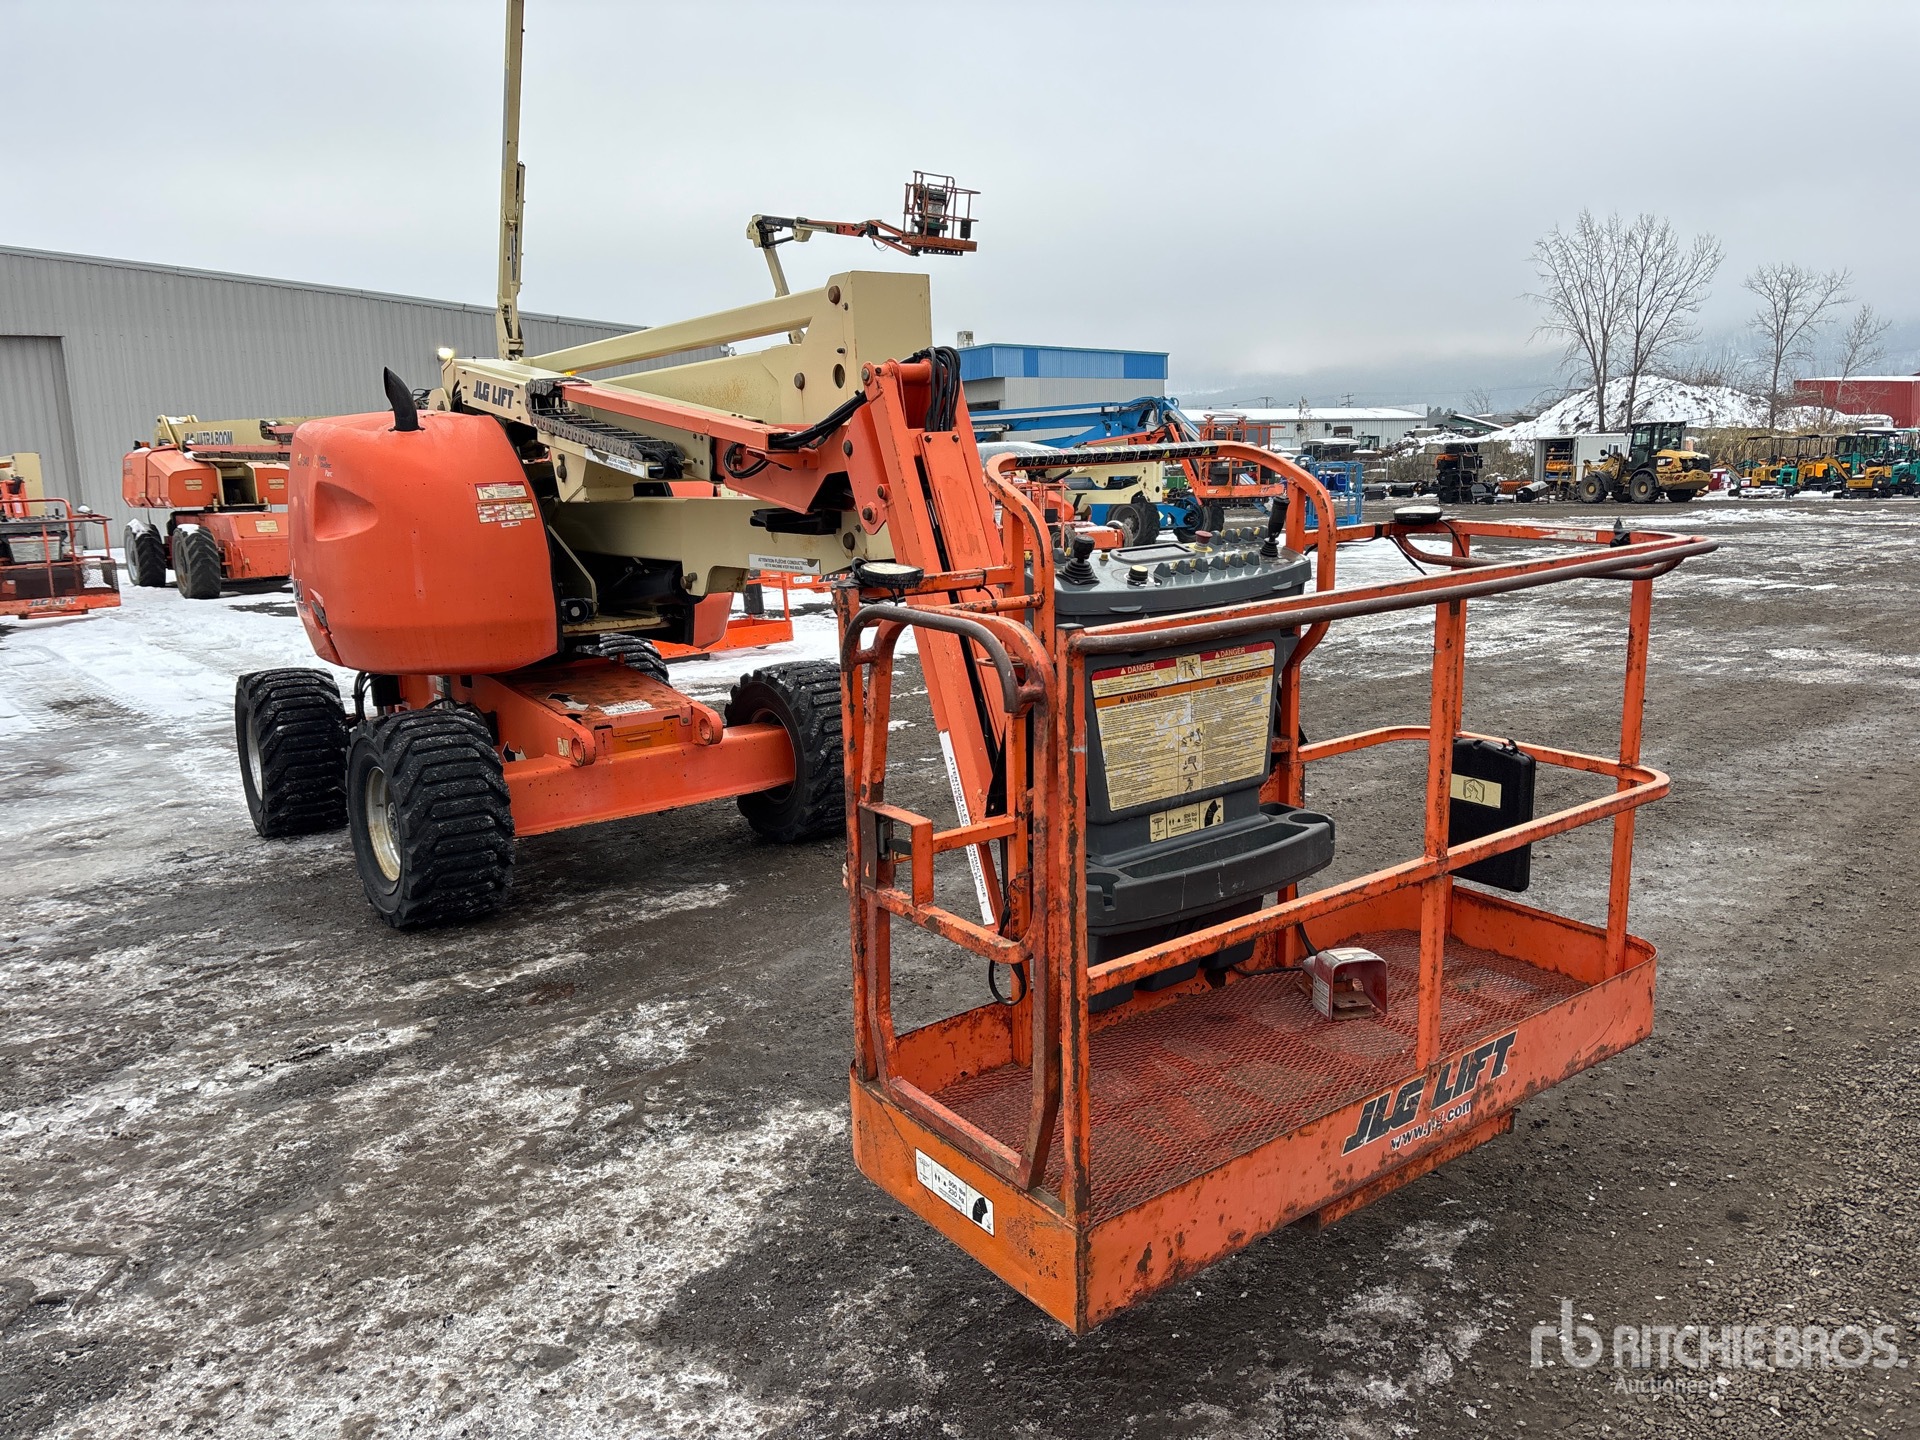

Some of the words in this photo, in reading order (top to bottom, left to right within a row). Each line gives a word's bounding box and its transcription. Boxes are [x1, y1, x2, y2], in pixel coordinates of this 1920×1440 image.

[473, 379, 490, 402] JLG
[492, 384, 514, 410] LIFT
[196, 432, 214, 446] ULTRA
[214, 430, 233, 446] BOOM
[1220, 647, 1246, 658] DANGER
[1127, 662, 1156, 674] DANGER
[1222, 676, 1236, 684] MISE
[1244, 670, 1262, 680] GARDE
[1127, 690, 1158, 702] WARNING
[948, 756, 963, 802] ATTENTION
[970, 844, 986, 898] ONDUCTRICE
[1341, 1074, 1427, 1157] JLG
[1430, 1029, 1518, 1112] LIFT
